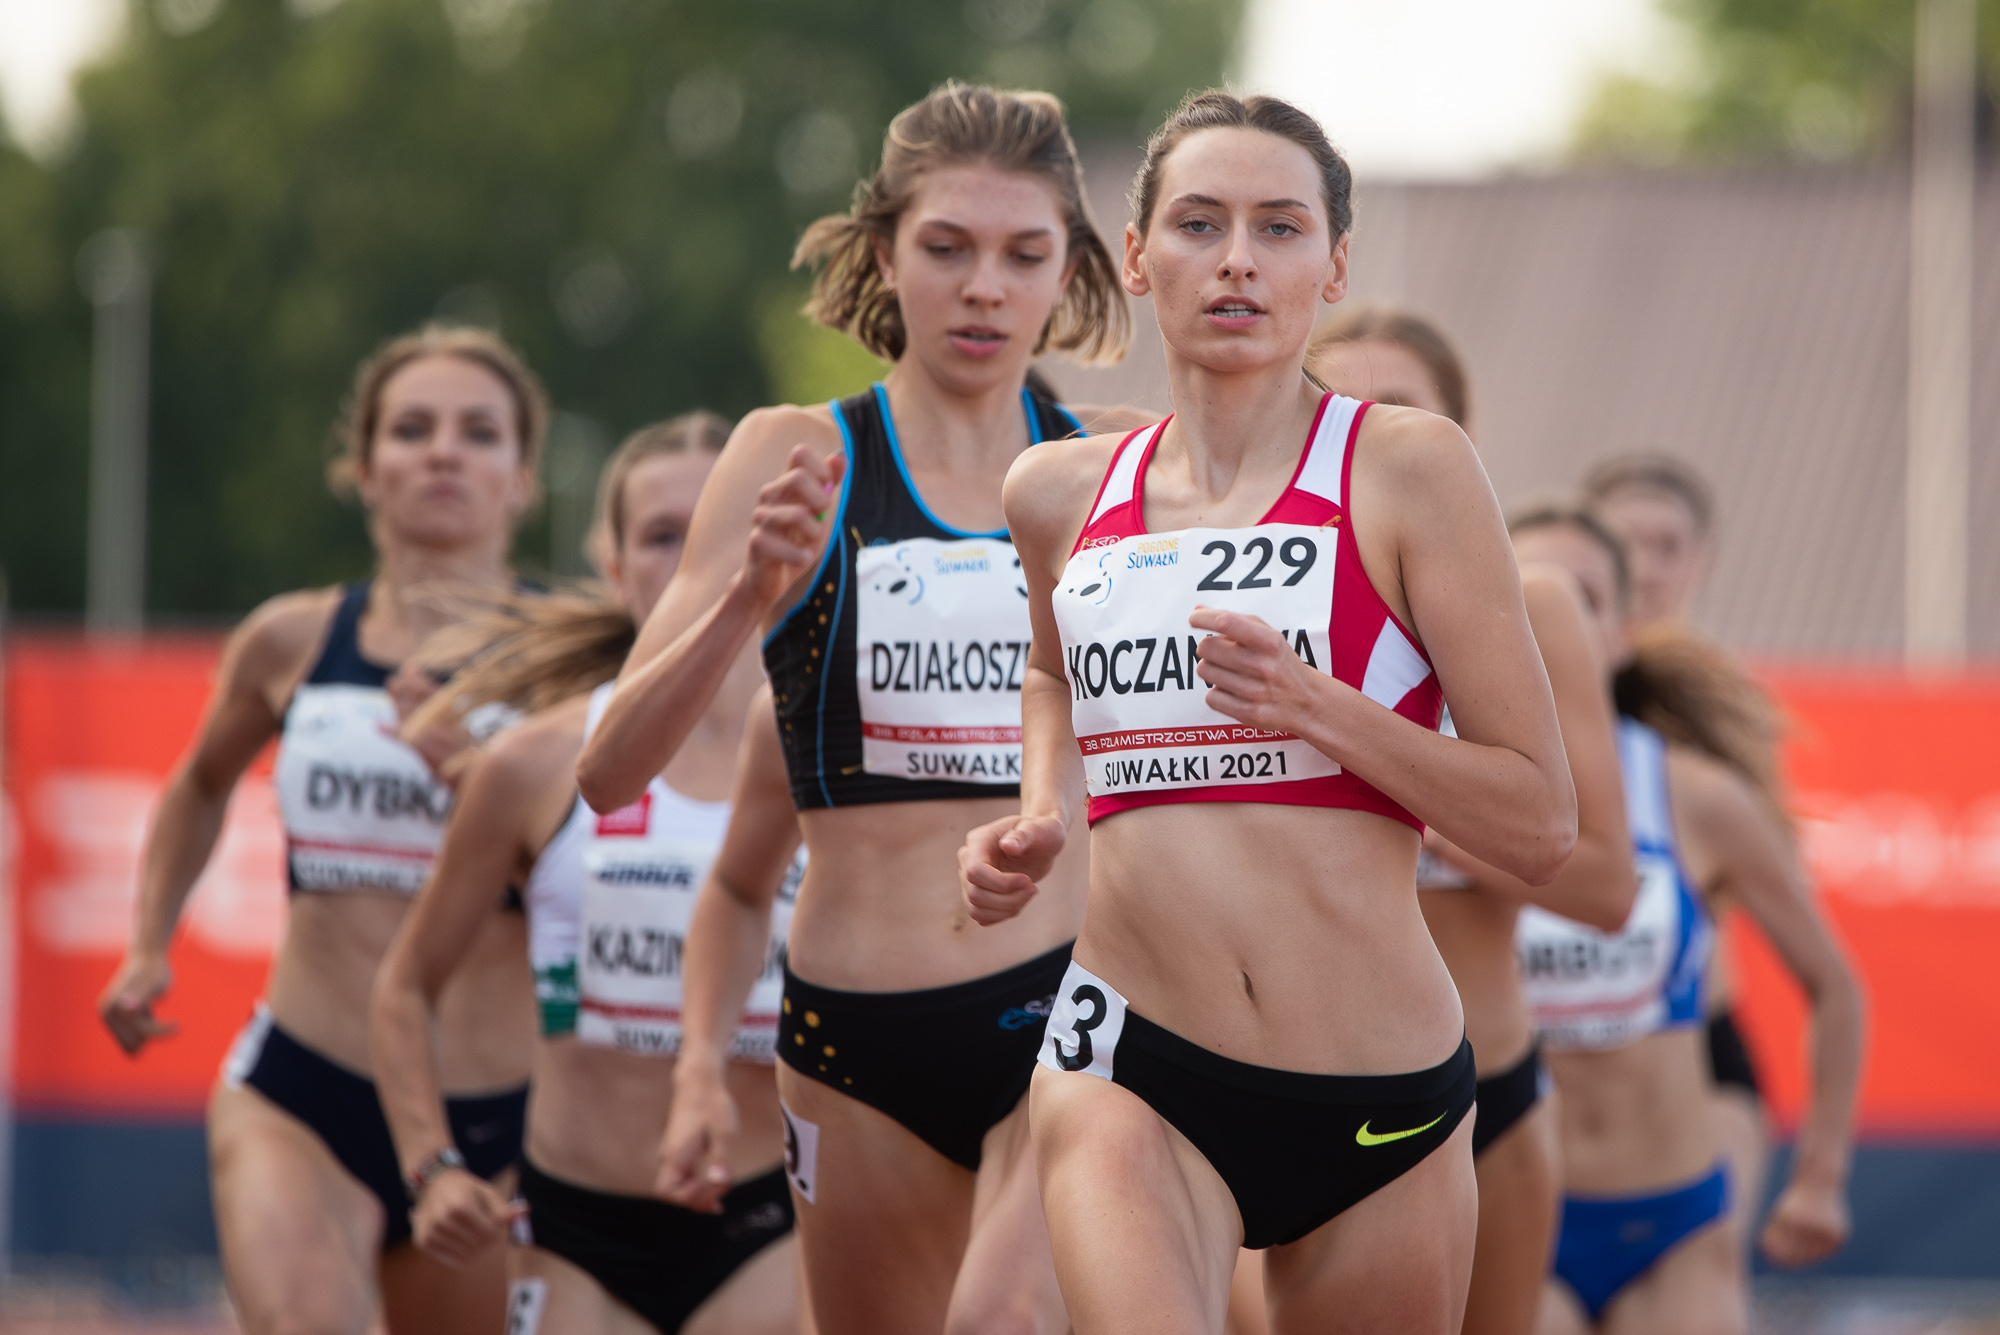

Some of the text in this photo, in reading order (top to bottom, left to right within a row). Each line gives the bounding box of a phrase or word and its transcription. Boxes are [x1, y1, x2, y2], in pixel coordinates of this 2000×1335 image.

[1137, 538, 1179, 553] POGODNE
[1127, 551, 1179, 569] SUWAŁKI
[1196, 536, 1317, 591] 229
[1120, 731, 1229, 746] MISTRZOSTWA
[907, 753, 1021, 776] SUWAŁK
[1105, 751, 1287, 787] SUWAŁKI 2021
[1054, 984, 1107, 1072] 3
